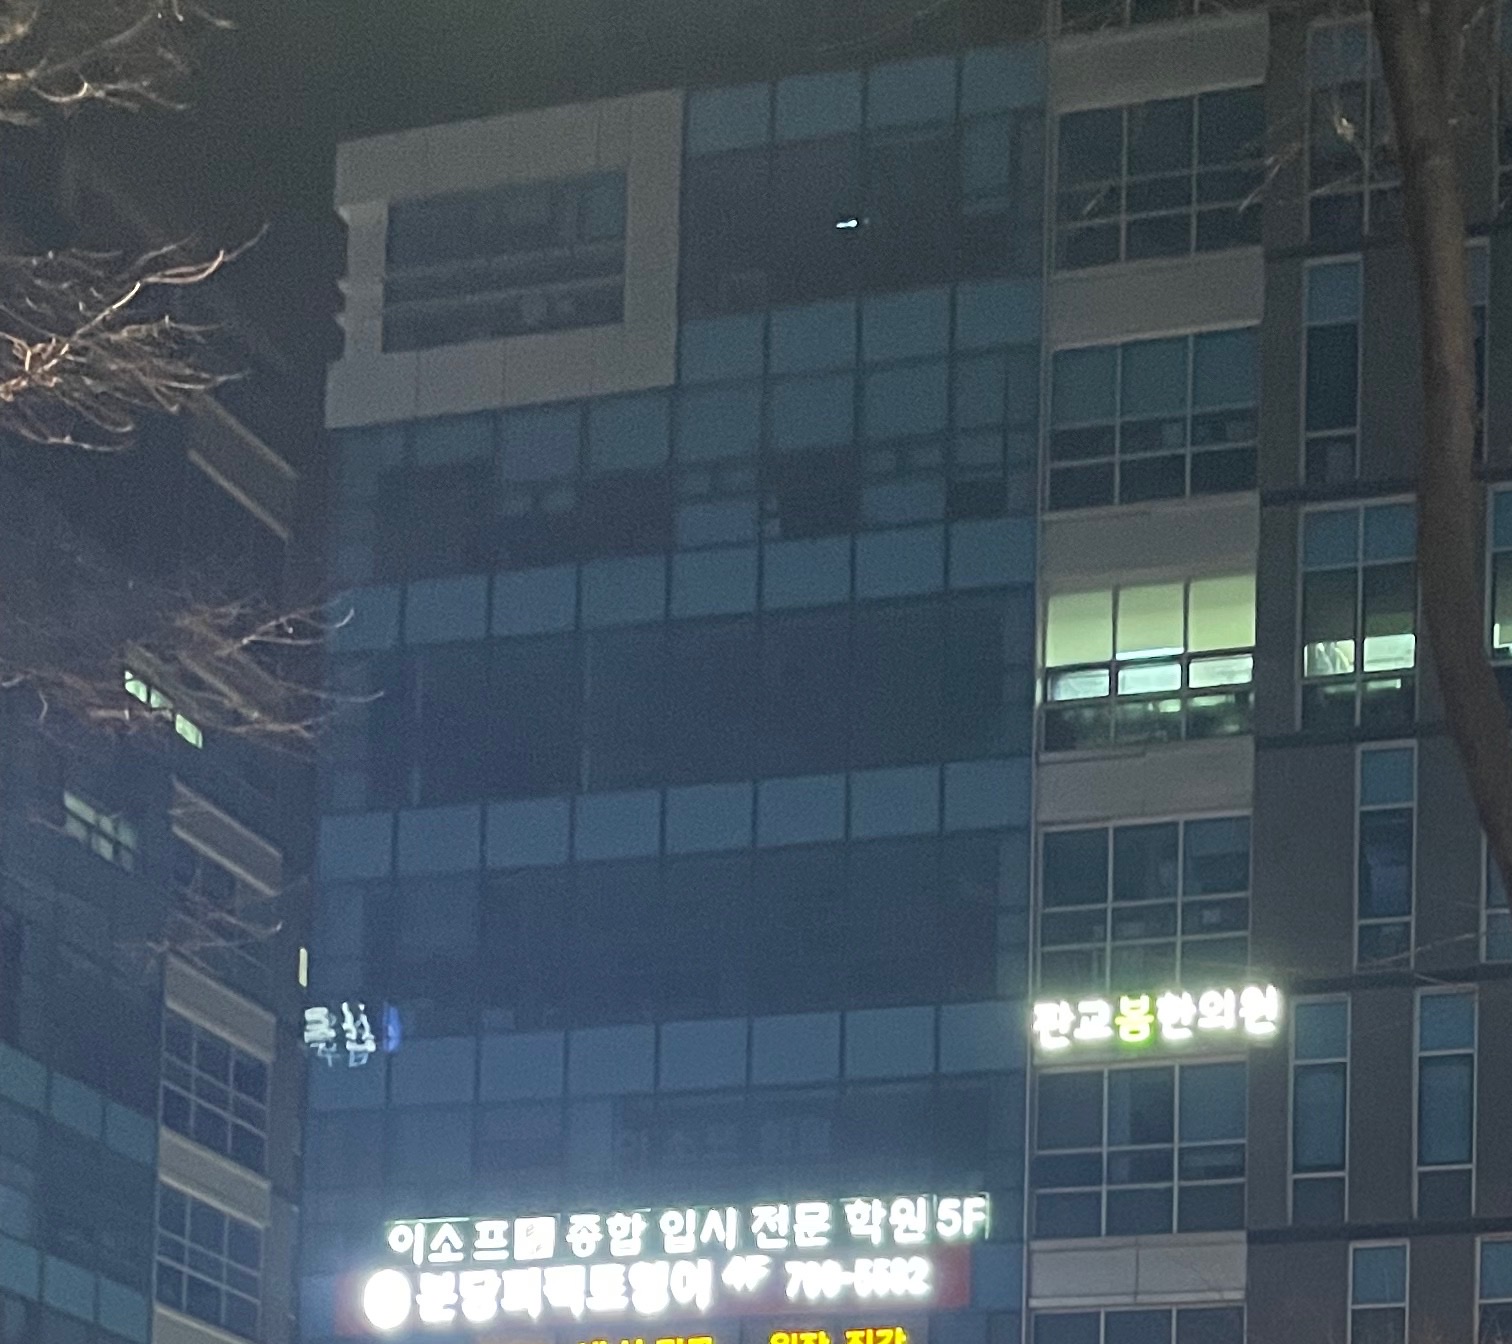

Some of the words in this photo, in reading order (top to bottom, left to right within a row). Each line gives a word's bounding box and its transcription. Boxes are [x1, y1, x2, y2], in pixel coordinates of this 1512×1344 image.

[565, 1202, 647, 1258] 종합
[659, 1207, 738, 1254] 입시
[751, 1201, 831, 1249] 전문
[844, 1195, 928, 1246] 학원
[936, 1196, 986, 1239] 5F
